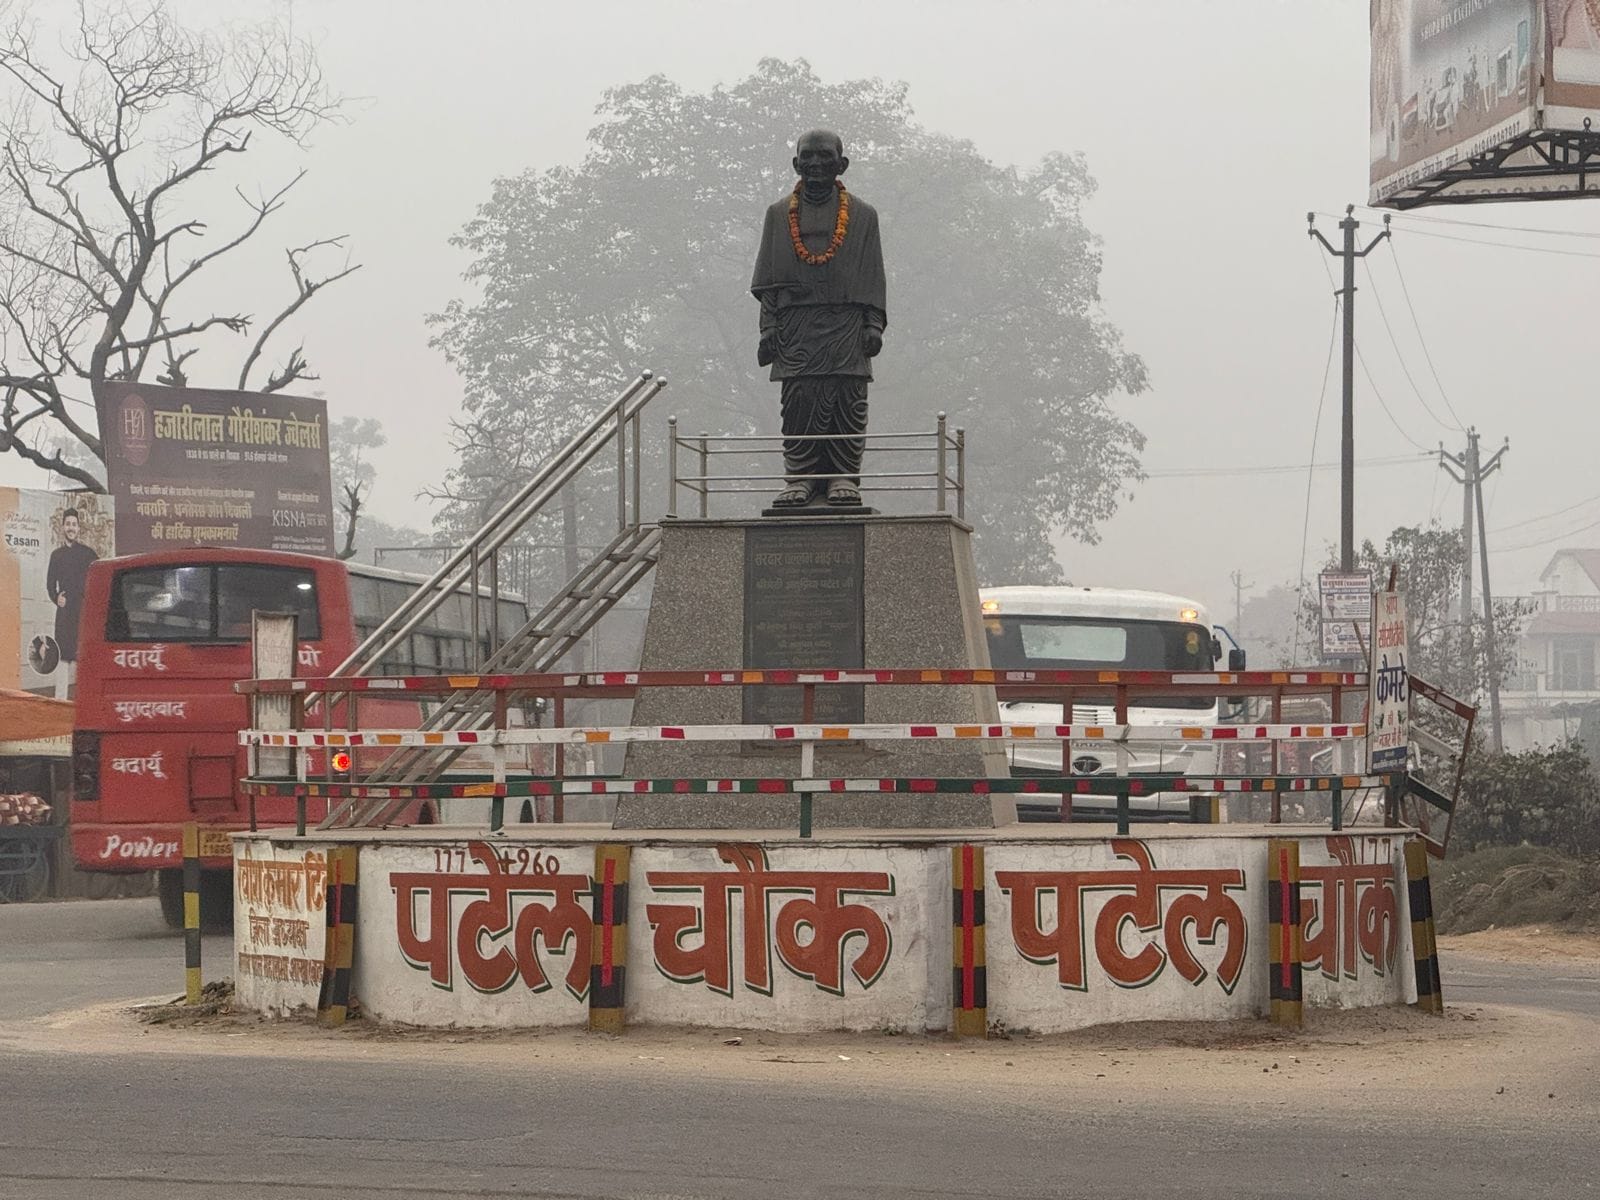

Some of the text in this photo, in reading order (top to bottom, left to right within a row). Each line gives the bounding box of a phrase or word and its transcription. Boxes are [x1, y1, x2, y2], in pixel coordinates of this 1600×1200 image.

[154, 403, 224, 442] हजारीलाल
[227, 406, 282, 446] गौरीशंकर
[272, 509, 306, 528] KISNA
[100, 834, 178, 860] Power
[434, 847, 465, 872] 177
[389, 841, 896, 1003] पटेल चौक
[995, 836, 1398, 996] पटेल चौक
